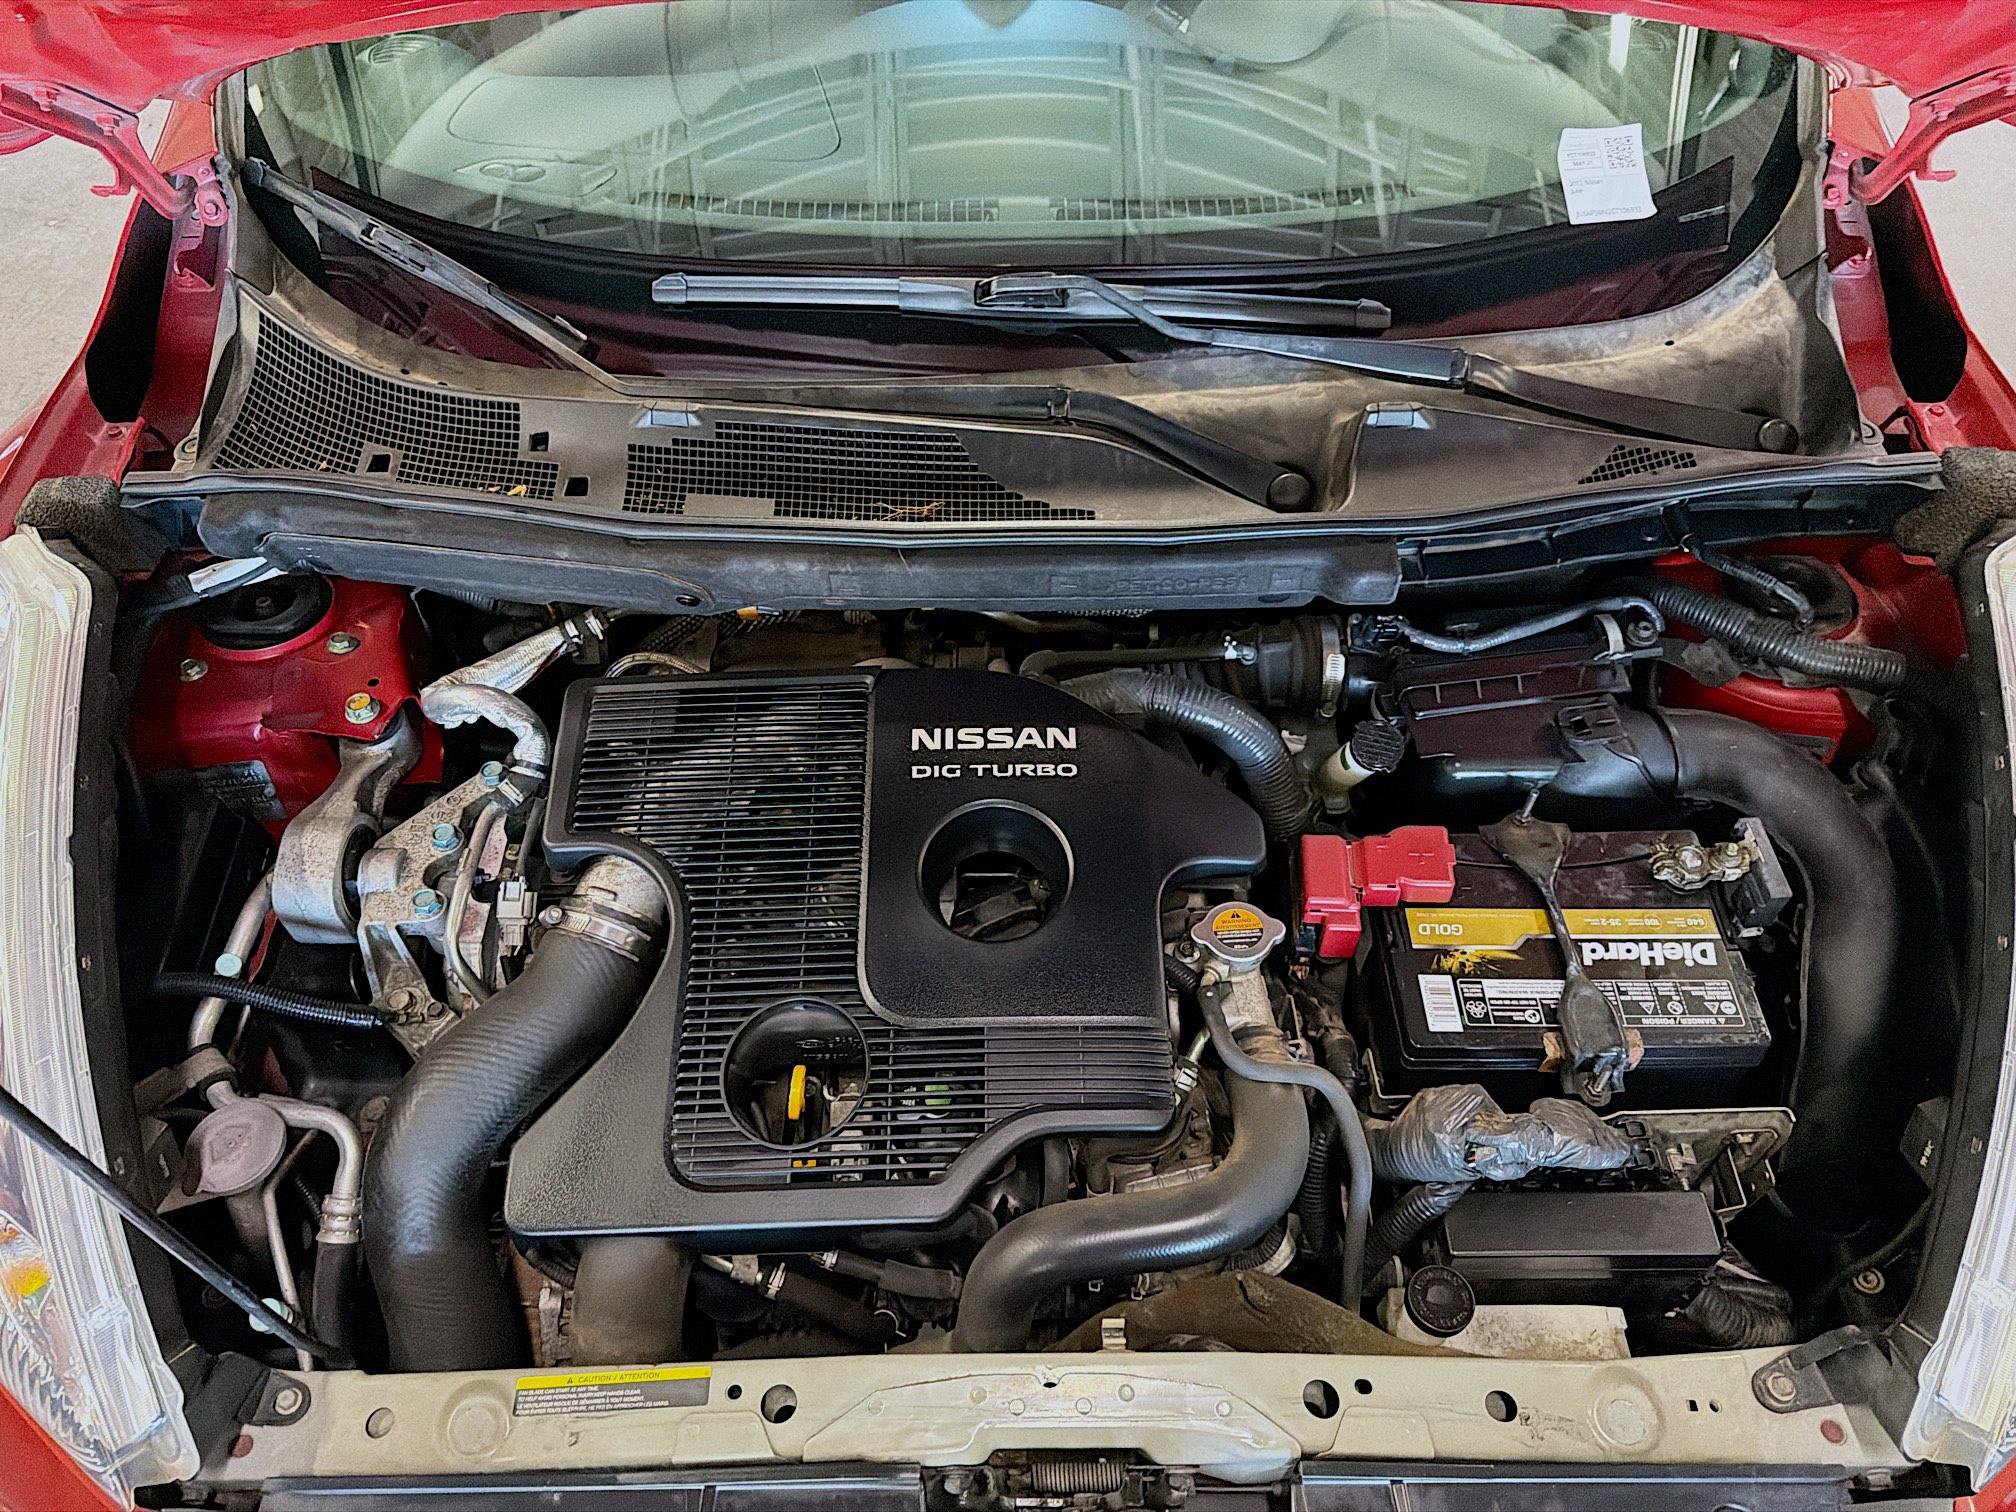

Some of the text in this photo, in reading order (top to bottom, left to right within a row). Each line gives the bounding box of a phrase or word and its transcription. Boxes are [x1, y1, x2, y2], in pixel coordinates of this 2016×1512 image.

[911, 727, 1077, 751] NISSAN
[911, 764, 1078, 778] DIG TURBO
[1644, 918, 1660, 926] 100
[1686, 918, 1705, 926] 640
[1418, 923, 1463, 936] GOLD
[1581, 941, 1717, 967] DieHard
[1642, 1017, 1676, 1025] POISON
[1680, 1017, 1717, 1025] DANGER
[578, 1375, 611, 1383] CAUTION
[620, 1371, 661, 1380] ATTENTION
